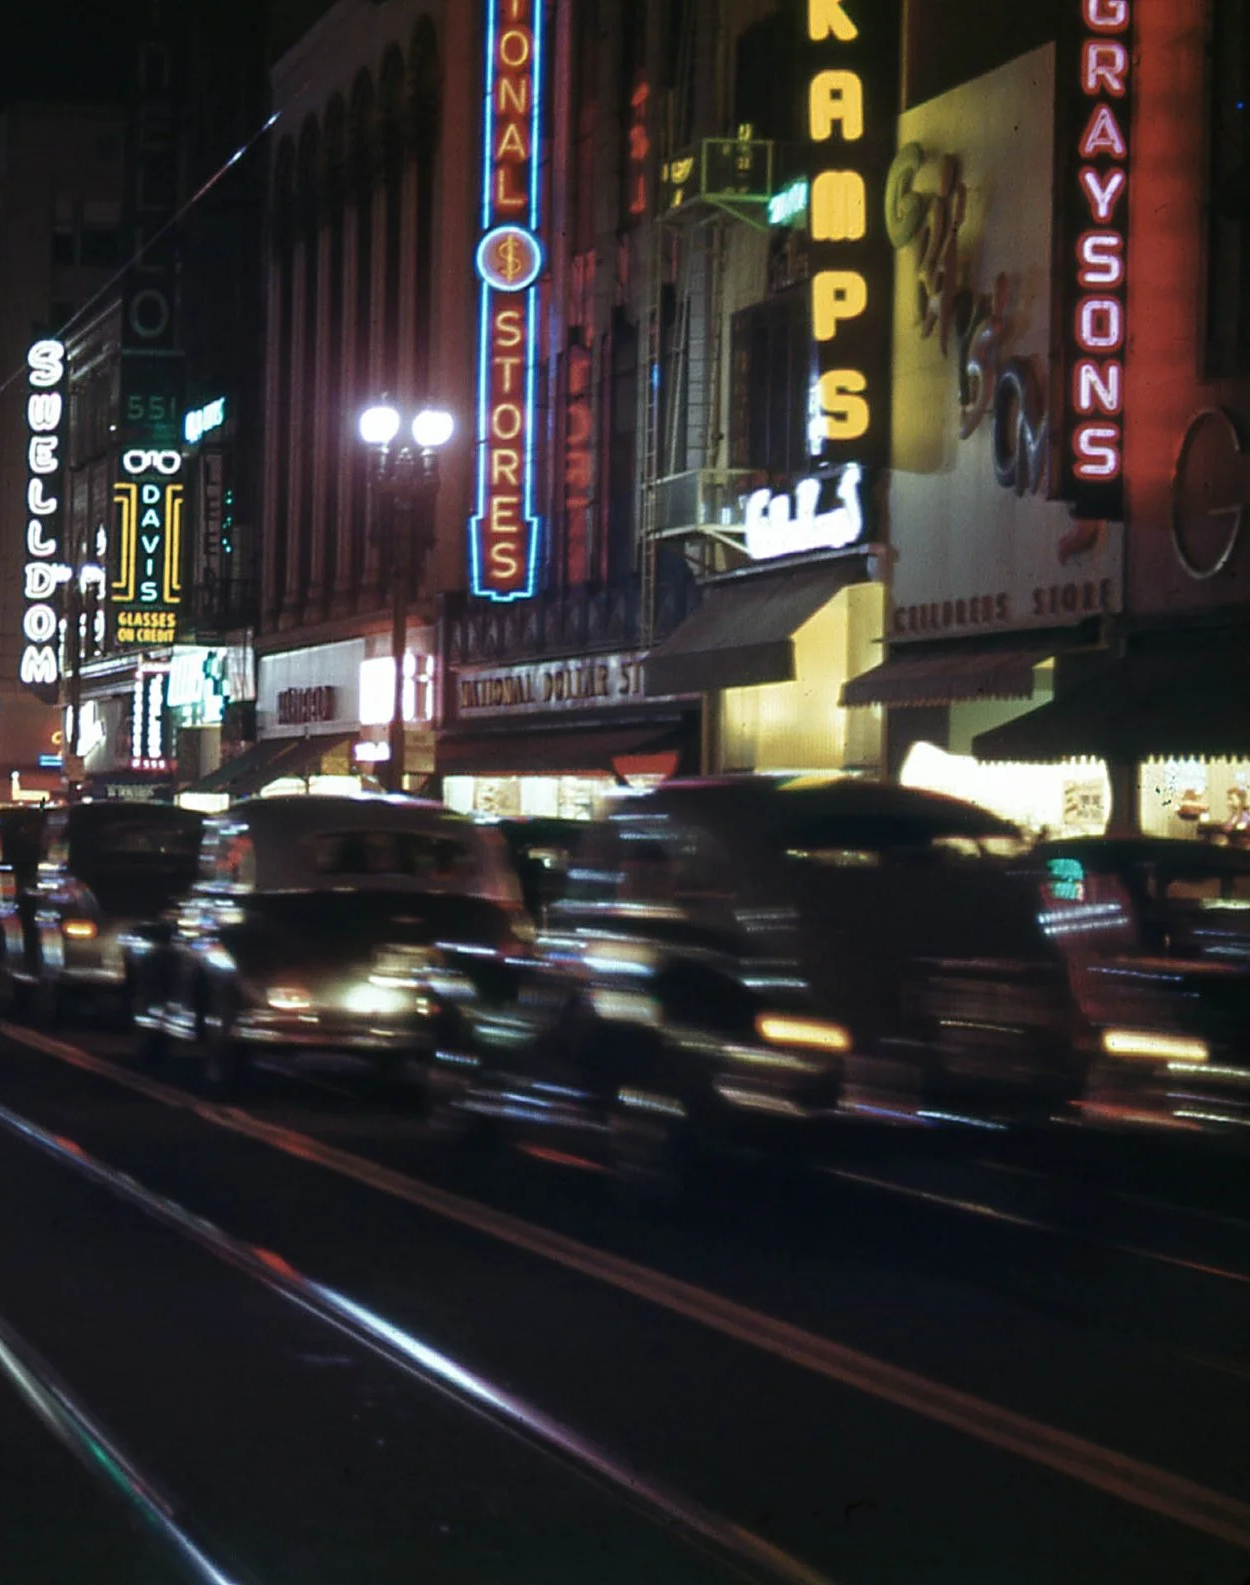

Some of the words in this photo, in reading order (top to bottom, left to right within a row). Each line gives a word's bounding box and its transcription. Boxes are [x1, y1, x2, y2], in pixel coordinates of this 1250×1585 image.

[808, 0, 870, 440] KAMPS
[1078, 0, 1127, 480] GRAYSONS
[21, 340, 65, 684] SWELLDOM
[492, 311, 522, 580] STORES
[117, 628, 134, 643] ON
[137, 626, 175, 643] CREDIT
[118, 611, 176, 628] GLASSES
[140, 484, 161, 602] DAVIS
[461, 673, 534, 709] NATIONAL
[542, 664, 609, 702] DOLLAR
